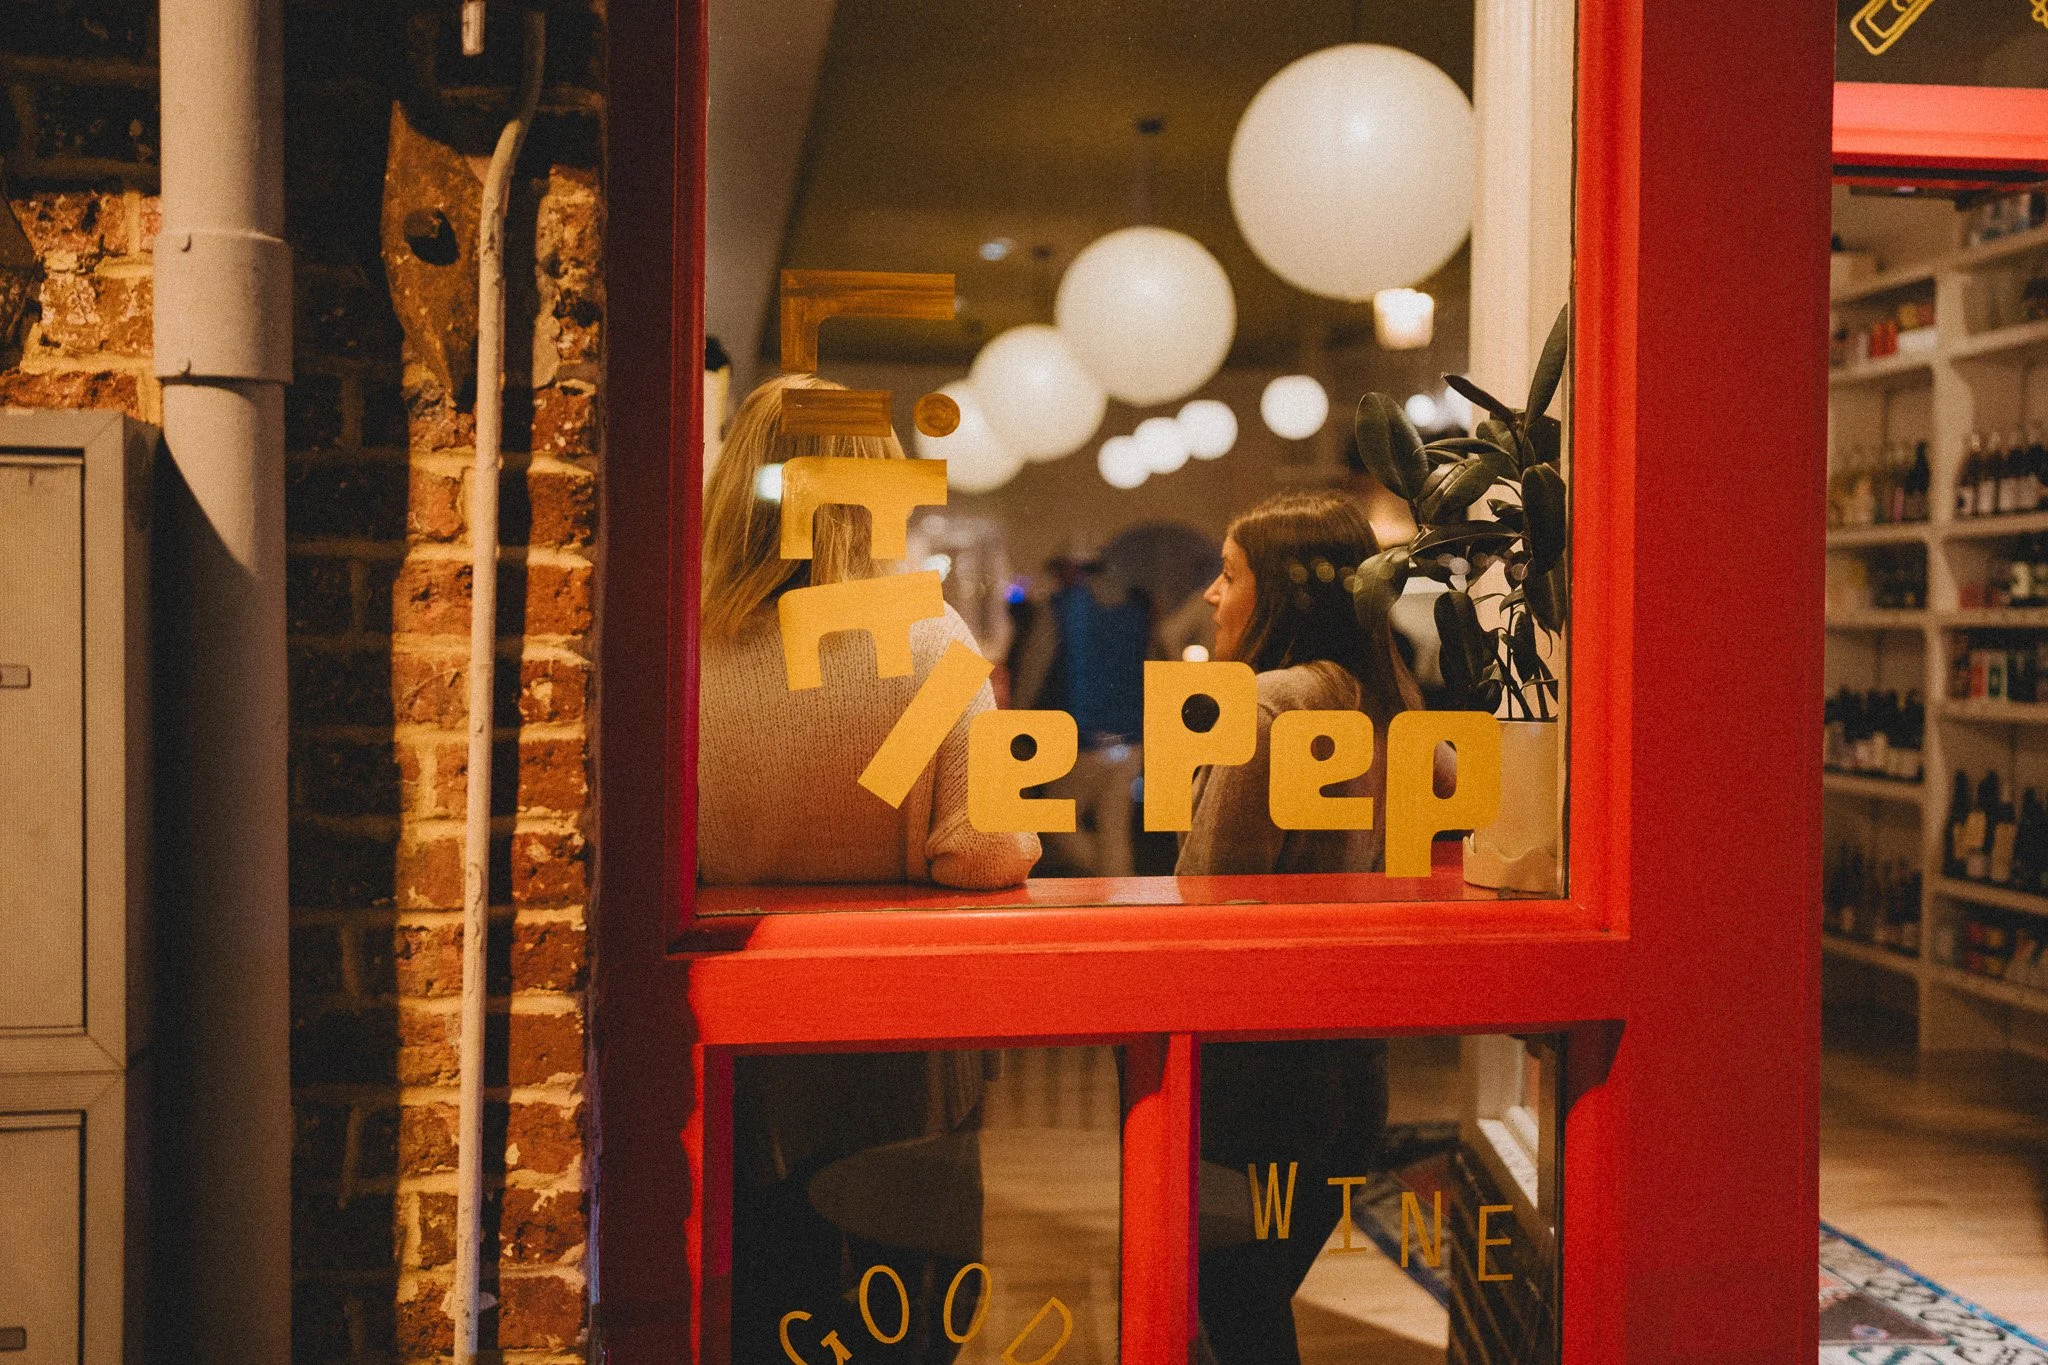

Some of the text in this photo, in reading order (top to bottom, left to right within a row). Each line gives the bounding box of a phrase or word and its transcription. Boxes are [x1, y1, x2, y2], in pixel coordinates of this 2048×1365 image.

[778, 269, 1501, 878] Little Pep
[1247, 1161, 1514, 1282] WINE
[779, 1262, 1073, 1365] GOOD
